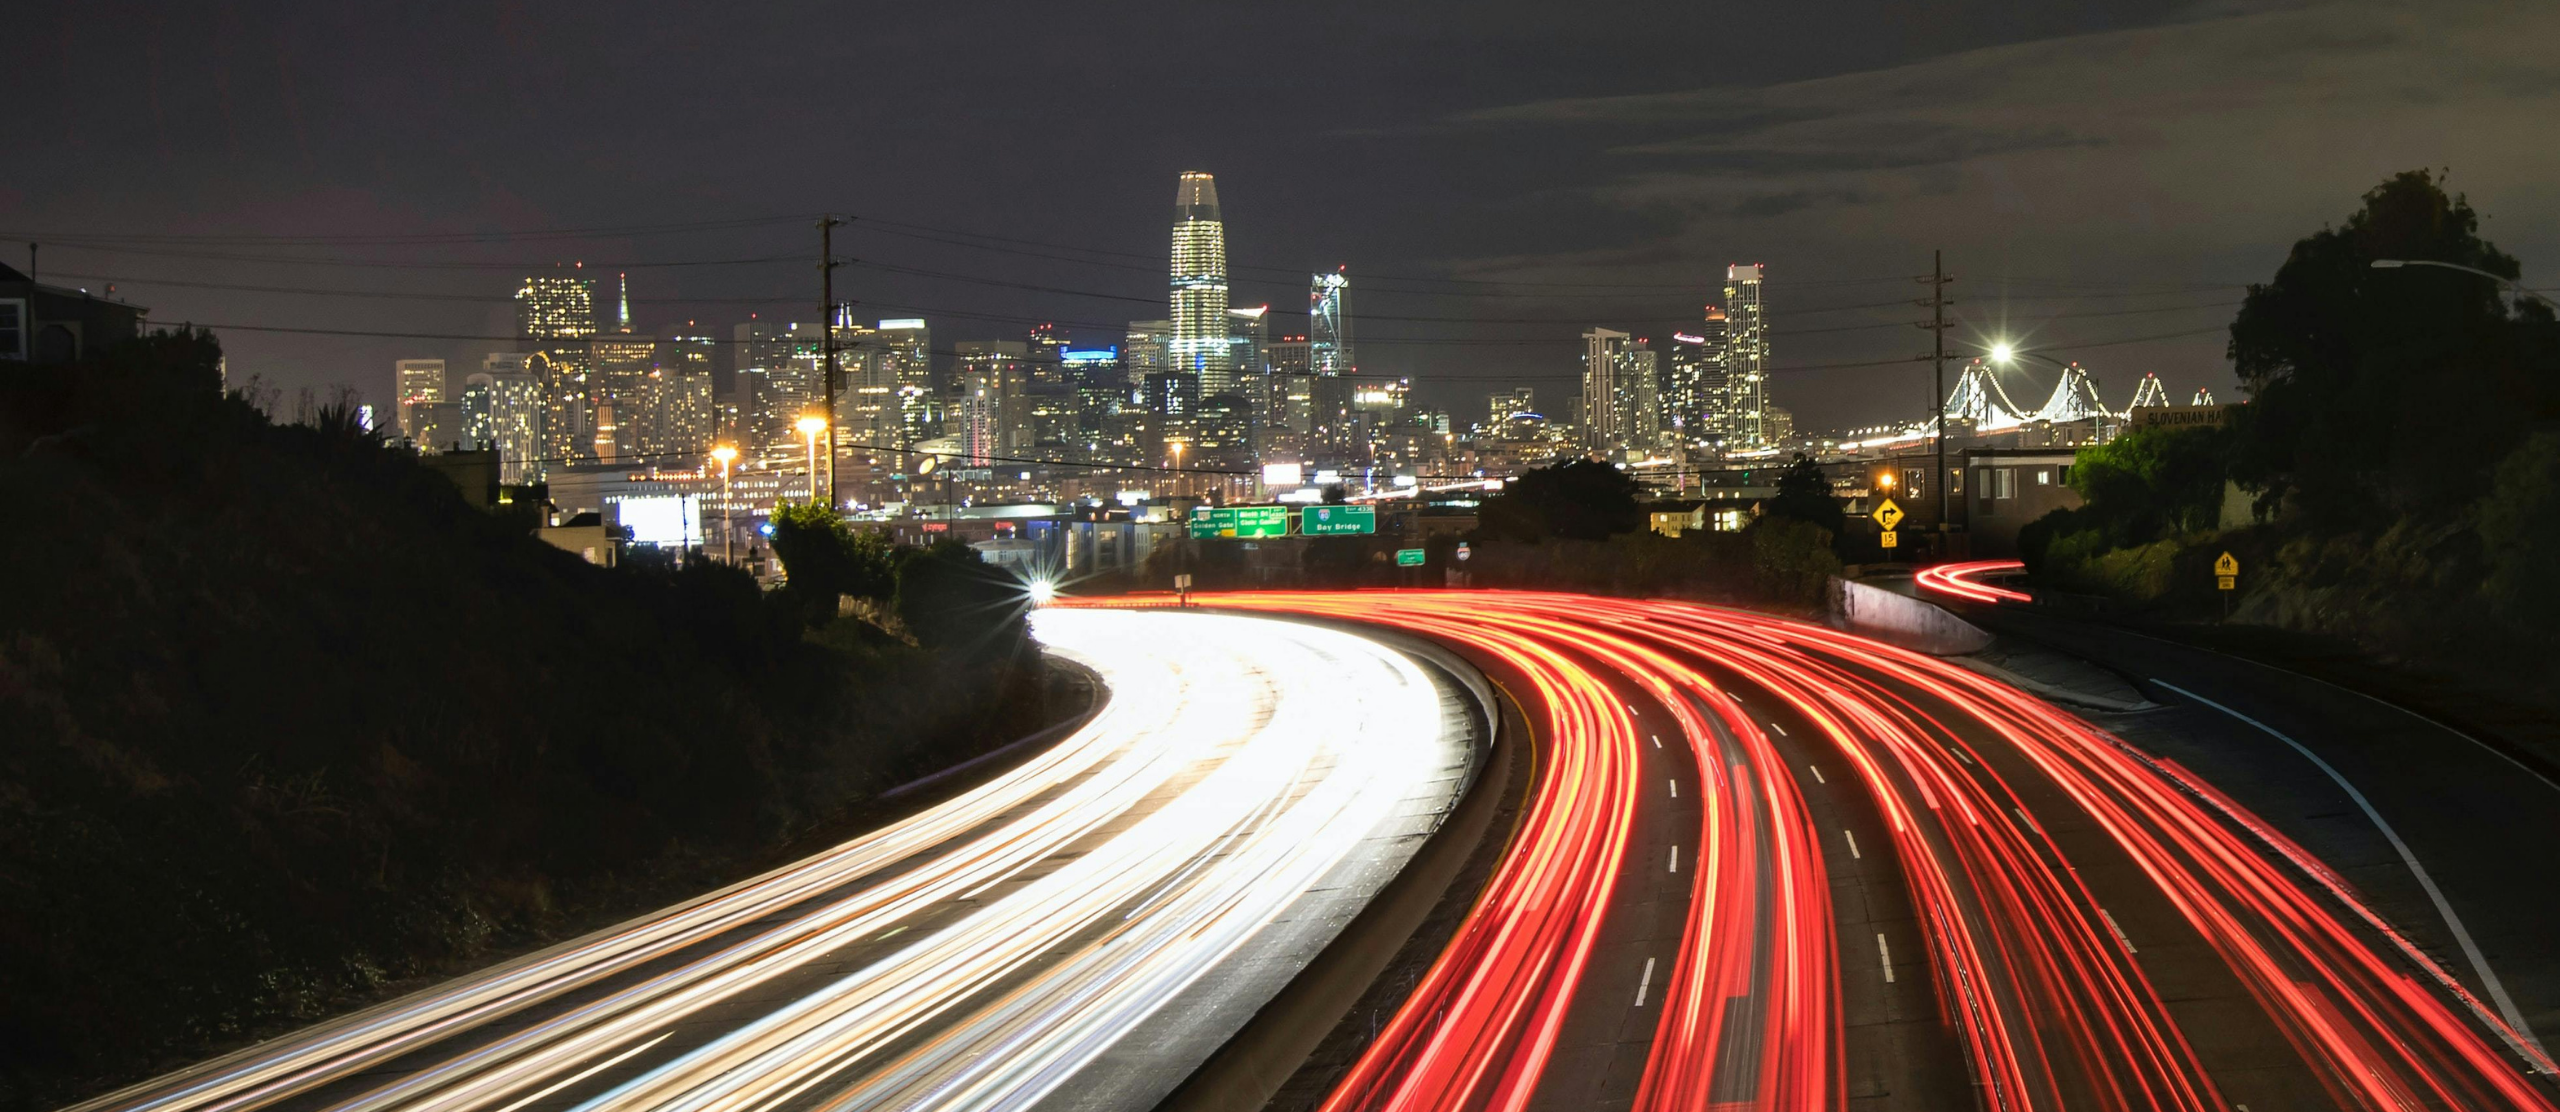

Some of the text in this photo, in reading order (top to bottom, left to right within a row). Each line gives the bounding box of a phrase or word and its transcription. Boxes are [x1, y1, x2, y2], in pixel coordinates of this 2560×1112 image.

[2148, 410, 2222, 425] SLOVENIAN HA
[1335, 523, 1361, 531] Bridge
[1884, 533, 1894, 543] 15
